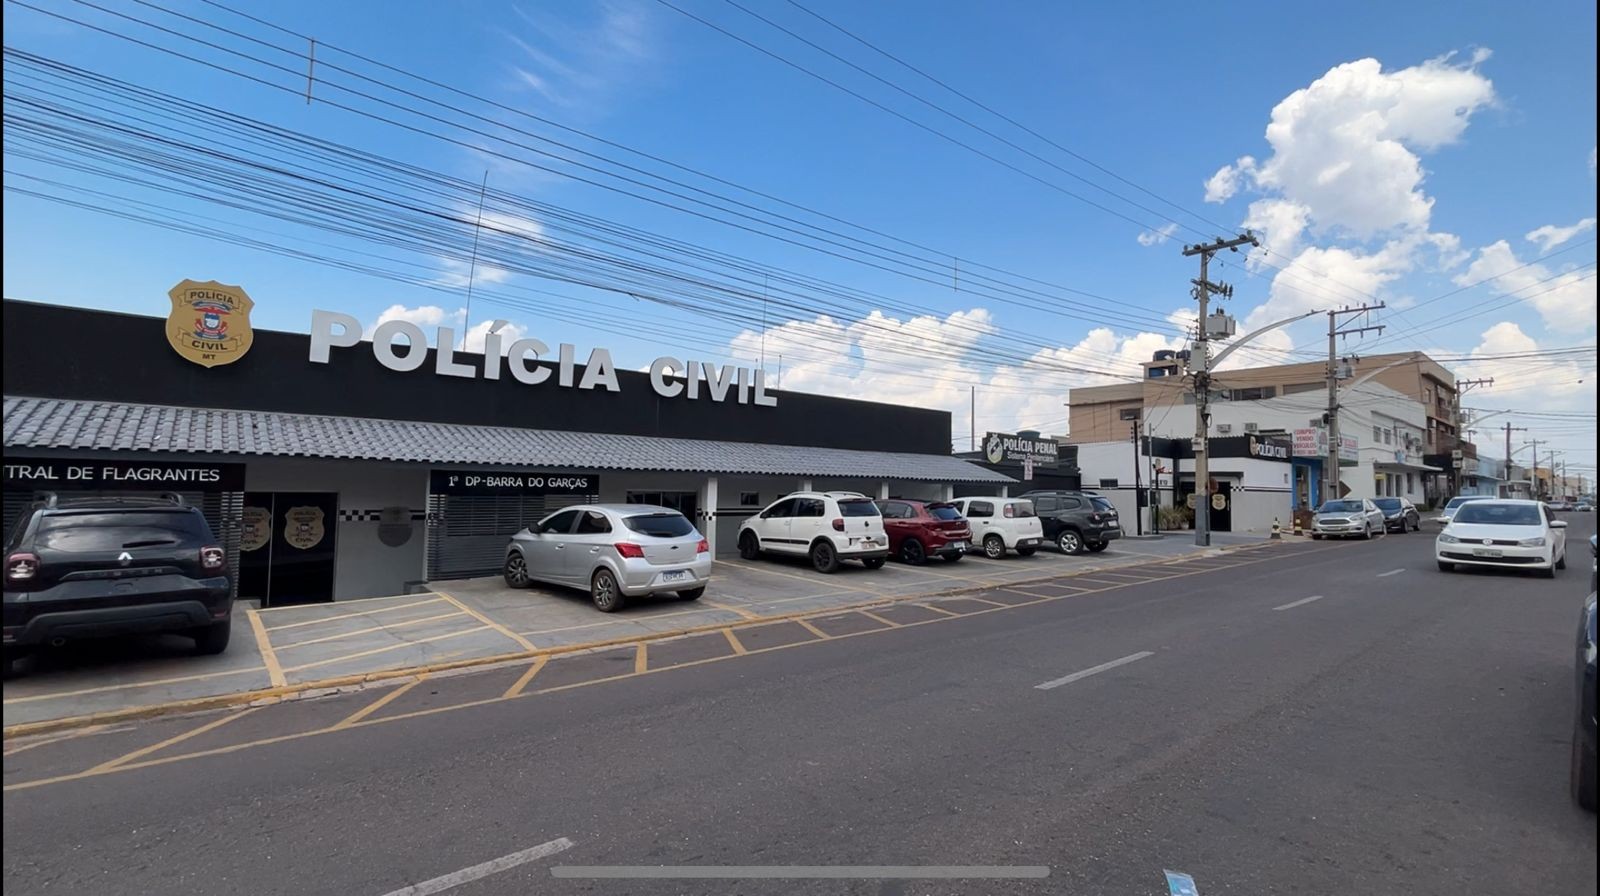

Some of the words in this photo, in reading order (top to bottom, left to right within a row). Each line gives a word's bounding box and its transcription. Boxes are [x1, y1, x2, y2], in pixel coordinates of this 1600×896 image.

[192, 340, 228, 350] CIVIL
[309, 309, 621, 392] POLÍCIA
[650, 356, 778, 407] CIVIL
[1003, 437, 1033, 453] POLÍCIA
[1035, 442, 1058, 455] PENAL
[4, 465, 59, 479] TRAL
[67, 466, 94, 480] DE
[102, 467, 220, 481] FLAGRANTES
[465, 476, 523, 487] DP-BARRA
[528, 477, 544, 487] DO
[547, 478, 588, 490] GARÇAS
